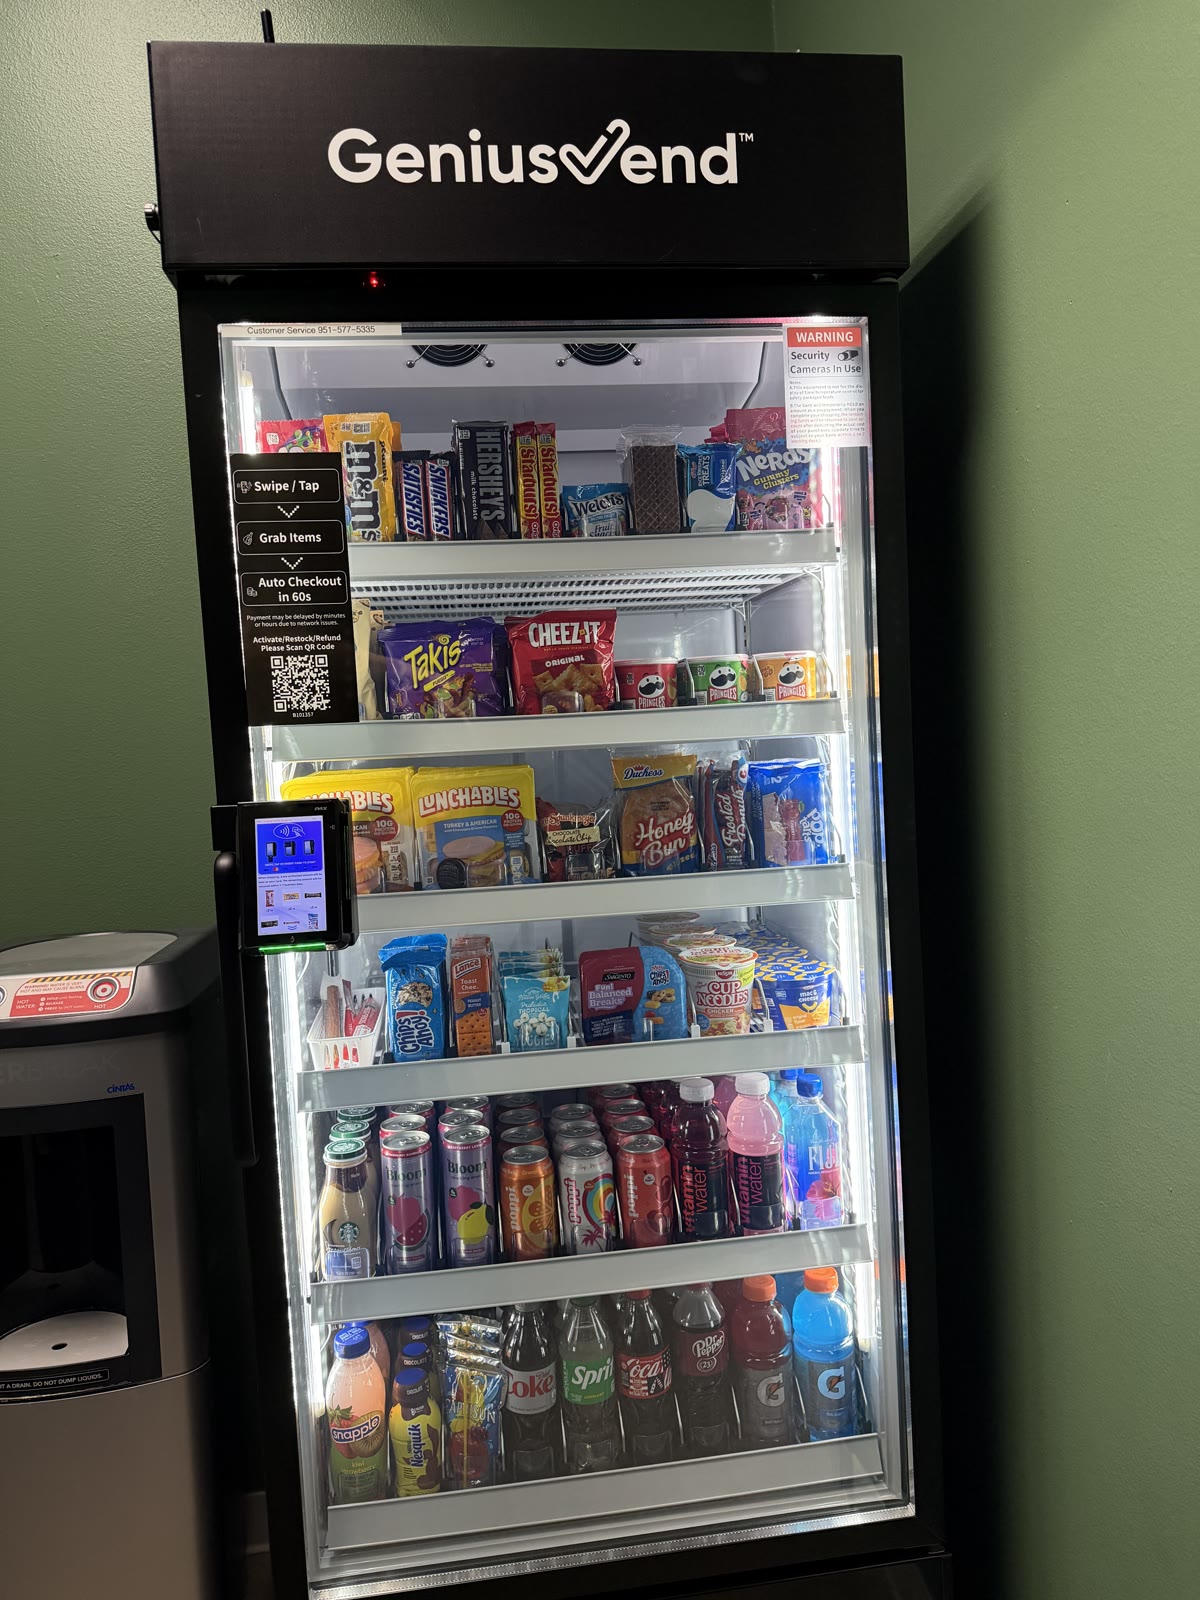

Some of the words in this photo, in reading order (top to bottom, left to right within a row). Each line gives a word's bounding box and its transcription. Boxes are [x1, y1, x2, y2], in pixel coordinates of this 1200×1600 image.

[247, 327, 285, 335] Customer
[287, 326, 316, 334] Service
[318, 325, 376, 334] 951-577-5335
[796, 331, 854, 343] WARNING
[791, 350, 830, 361] Security
[790, 365, 831, 374] Cameras
[833, 365, 842, 373] In
[844, 364, 862, 373] Use
[475, 431, 505, 521] HERSHEY'S
[702, 455, 710, 485] TREATS
[753, 469, 790, 487] Gummy
[254, 480, 289, 494] Swipe
[291, 480, 296, 493] /
[298, 480, 320, 493] Tap
[518, 446, 539, 519] Starburst
[539, 446, 560, 519] Starburst
[763, 473, 800, 490] Clusters
[402, 462, 424, 536] SATISFIES
[428, 462, 451, 538] SNICKERS
[572, 493, 624, 516] Welch's
[259, 532, 287, 544] Grab
[289, 532, 322, 543] Items
[258, 577, 285, 588] Auto
[288, 576, 342, 587] Checkout
[278, 592, 290, 602] in
[292, 592, 312, 602] 60s
[252, 634, 342, 644] Activate/Restock/Refund
[261, 644, 285, 652] Please
[404, 634, 461, 689] Takis
[710, 688, 737, 701] PRINGLES
[778, 684, 806, 699] PRINGLES
[624, 767, 663, 780] Duchess
[418, 785, 521, 818] LUNCHABLES
[376, 820, 393, 828] 10G
[470, 819, 497, 827] AMERICAN
[635, 812, 694, 846] Honey
[717, 794, 736, 847] Frosted
[807, 808, 824, 844] pop
[643, 838, 686, 866] Bun
[454, 959, 480, 975] Lance
[589, 987, 632, 999] Balanced
[708, 981, 742, 994] CUP
[589, 998, 623, 1007] Breaks
[696, 989, 749, 1007] NOODLES
[397, 1016, 422, 1055] Chips
[447, 1158, 487, 1174] Bloom
[808, 1143, 840, 1171] FIJI
[386, 1166, 427, 1182] Bloom
[749, 1159, 763, 1205] water
[623, 1173, 639, 1218] poppi
[680, 1164, 696, 1233] vitamin
[694, 1167, 708, 1213] water
[737, 1156, 750, 1225] vitamin
[505, 1186, 521, 1231] poppi
[565, 1177, 581, 1224] poppi
[695, 1336, 724, 1358] Pepper
[704, 1335, 718, 1346] Dr
[702, 1361, 711, 1370] 23
[58, 1377, 77, 1385] DUMP
[77, 1373, 103, 1382] LIQUIDS.
[818, 1366, 846, 1400] G
[757, 1373, 785, 1407] G
[332, 1416, 381, 1442] snapple
[408, 1423, 424, 1467] Nesquik
[351, 1460, 365, 1468] kiwi
